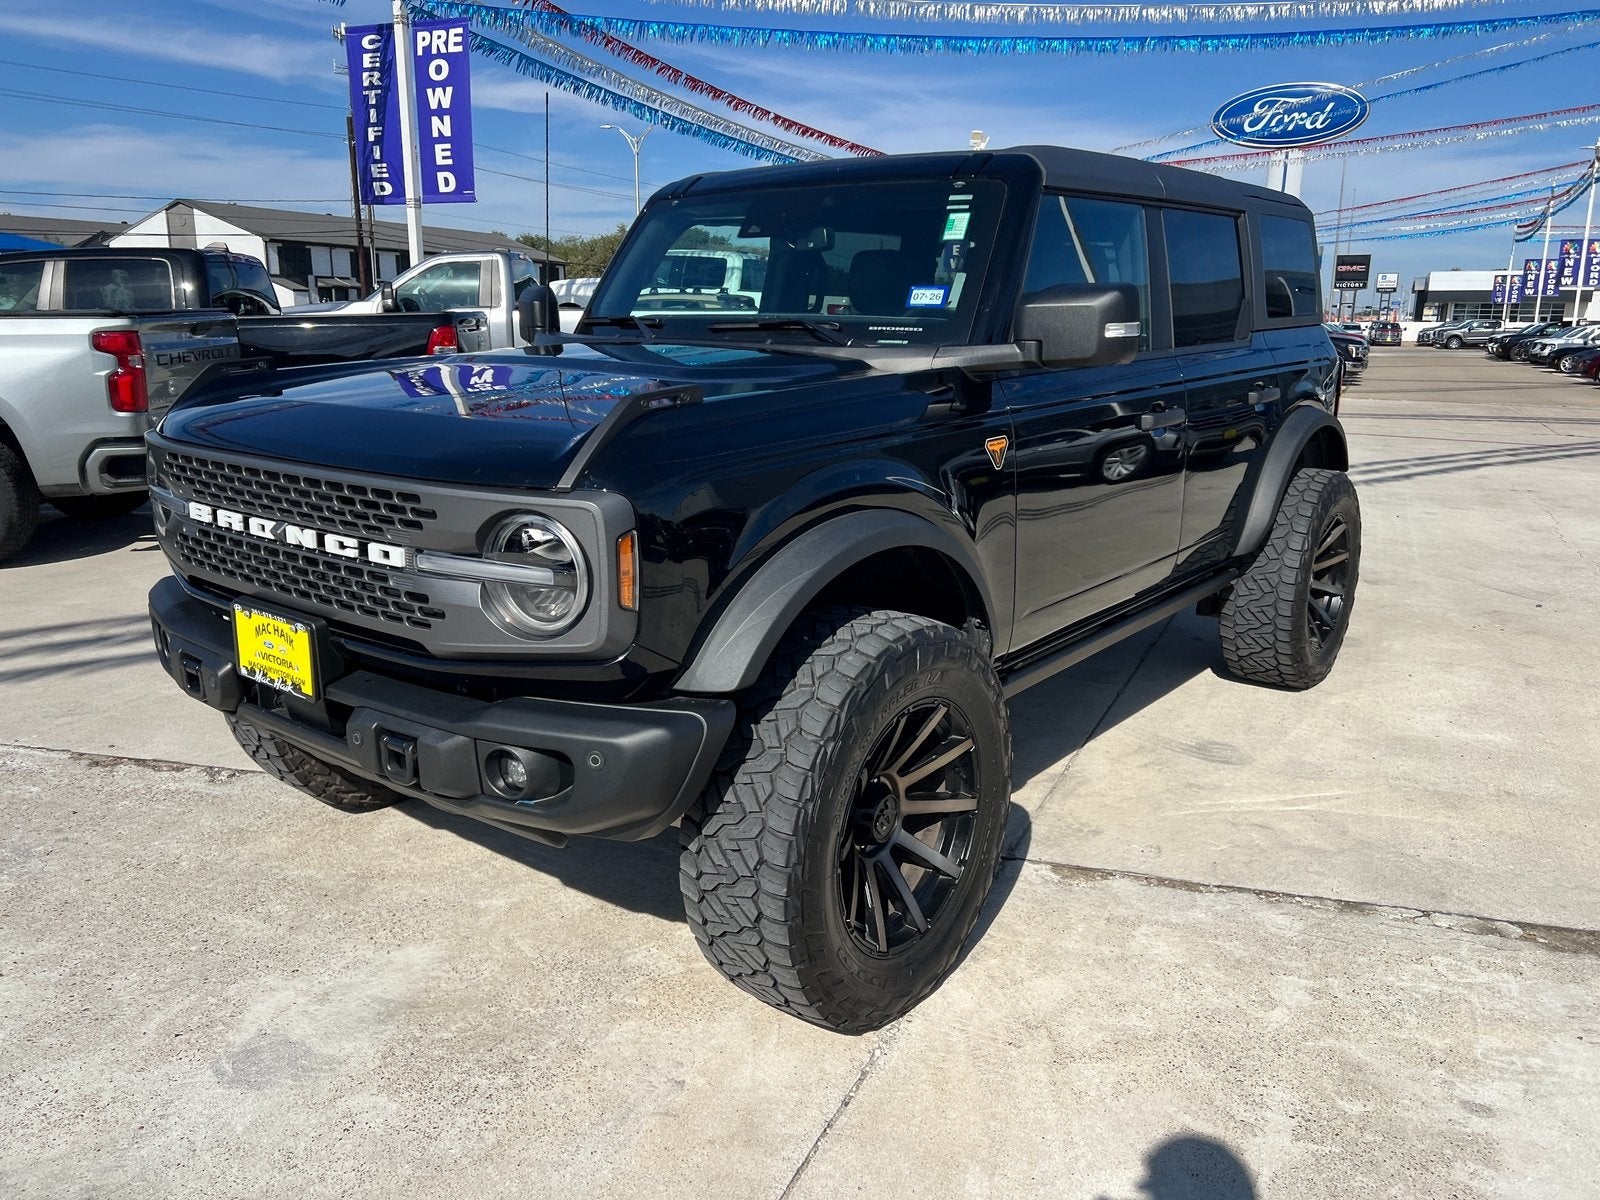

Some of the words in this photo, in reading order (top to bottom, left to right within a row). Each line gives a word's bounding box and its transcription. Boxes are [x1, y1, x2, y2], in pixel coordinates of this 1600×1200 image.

[416, 27, 463, 56] PRE
[361, 34, 393, 196] CERTIFIED
[426, 58, 457, 193] OWNED
[1243, 97, 1335, 134] Ford
[1524, 273, 1536, 295] NEW
[1546, 273, 1557, 295] FORD
[1560, 258, 1574, 286] NEW
[1588, 257, 1600, 286] FORD
[912, 292, 926, 301] 07
[929, 292, 942, 301] 26
[188, 501, 406, 568] BRONCO
[254, 622, 272, 638] MAC
[273, 624, 295, 650] HAIK
[260, 650, 294, 670] VICTORIA
